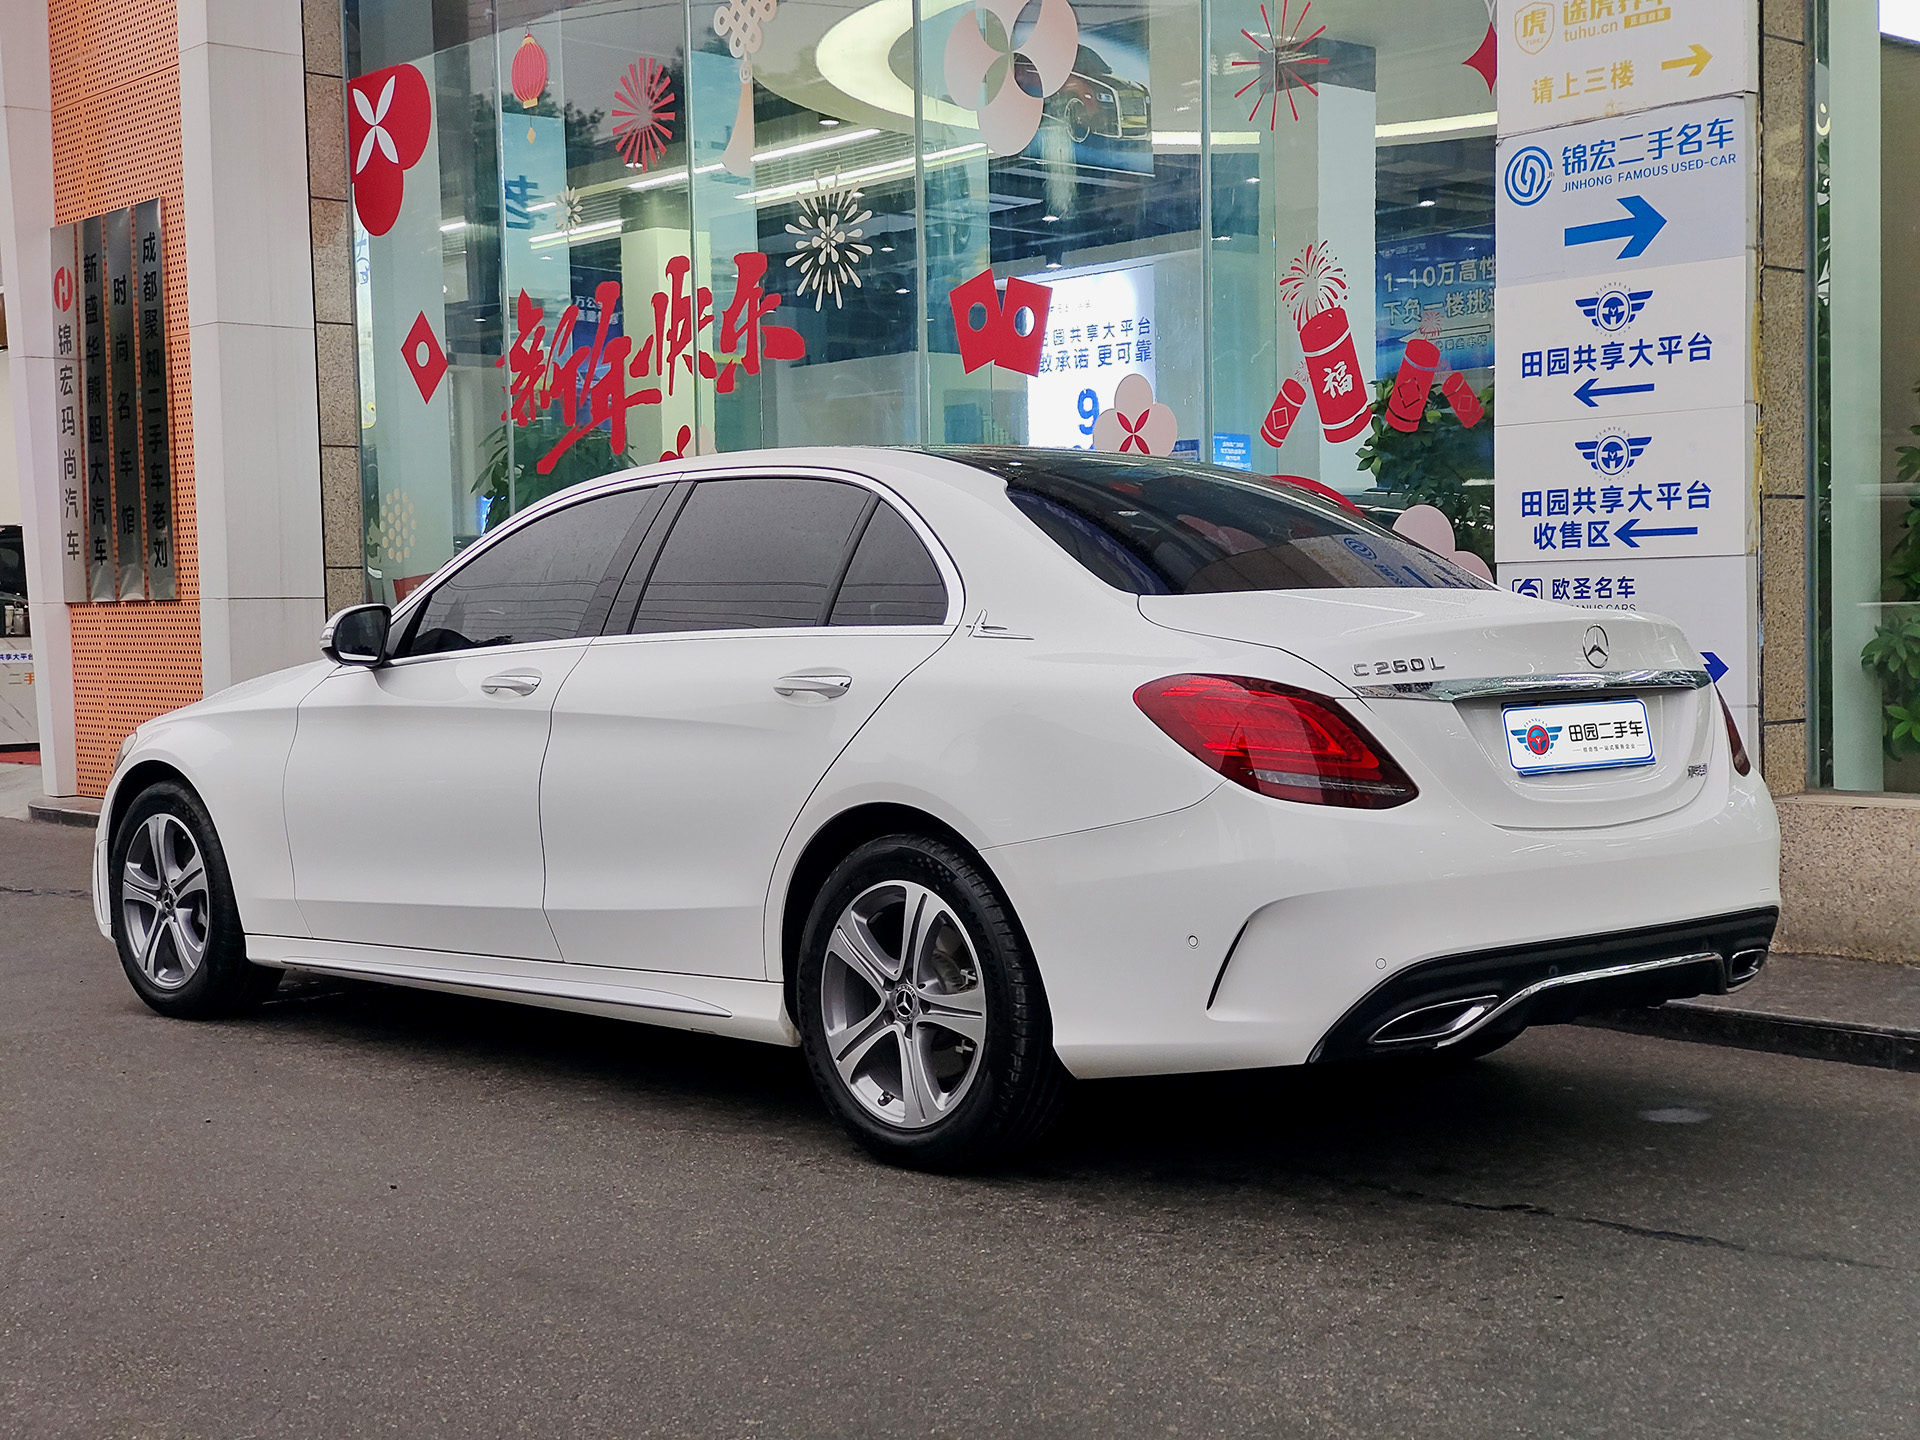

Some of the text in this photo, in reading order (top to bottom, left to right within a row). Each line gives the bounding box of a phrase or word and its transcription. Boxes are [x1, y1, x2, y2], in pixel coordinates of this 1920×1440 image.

[1522, 8, 1547, 38] 虎
[1563, 0, 1663, 26] 途虎
[1564, 21, 1618, 42] tuhu.cn
[1531, 60, 1634, 104] 请上三楼
[1561, 118, 1735, 177] 锦宏二手名车
[1561, 153, 1737, 193] JINHONG FAMOUS USED-CAR
[495, 251, 806, 474] 新年快乐
[1097, 339, 1152, 368] 更可靠
[1521, 332, 1713, 379] 田园共享大平台
[1322, 361, 1353, 399] 福
[112, 277, 135, 536] 时尚名车馆
[1077, 388, 1100, 435] 9
[57, 323, 80, 562] 锦宏玛尚汽车
[1521, 480, 1713, 518] 田园共享大平台
[1533, 520, 1611, 551] 收售区
[1552, 576, 1636, 600] 欧圣名车
[1352, 655, 1446, 677] C 260 L
[1568, 720, 1644, 742] 田园二手车
